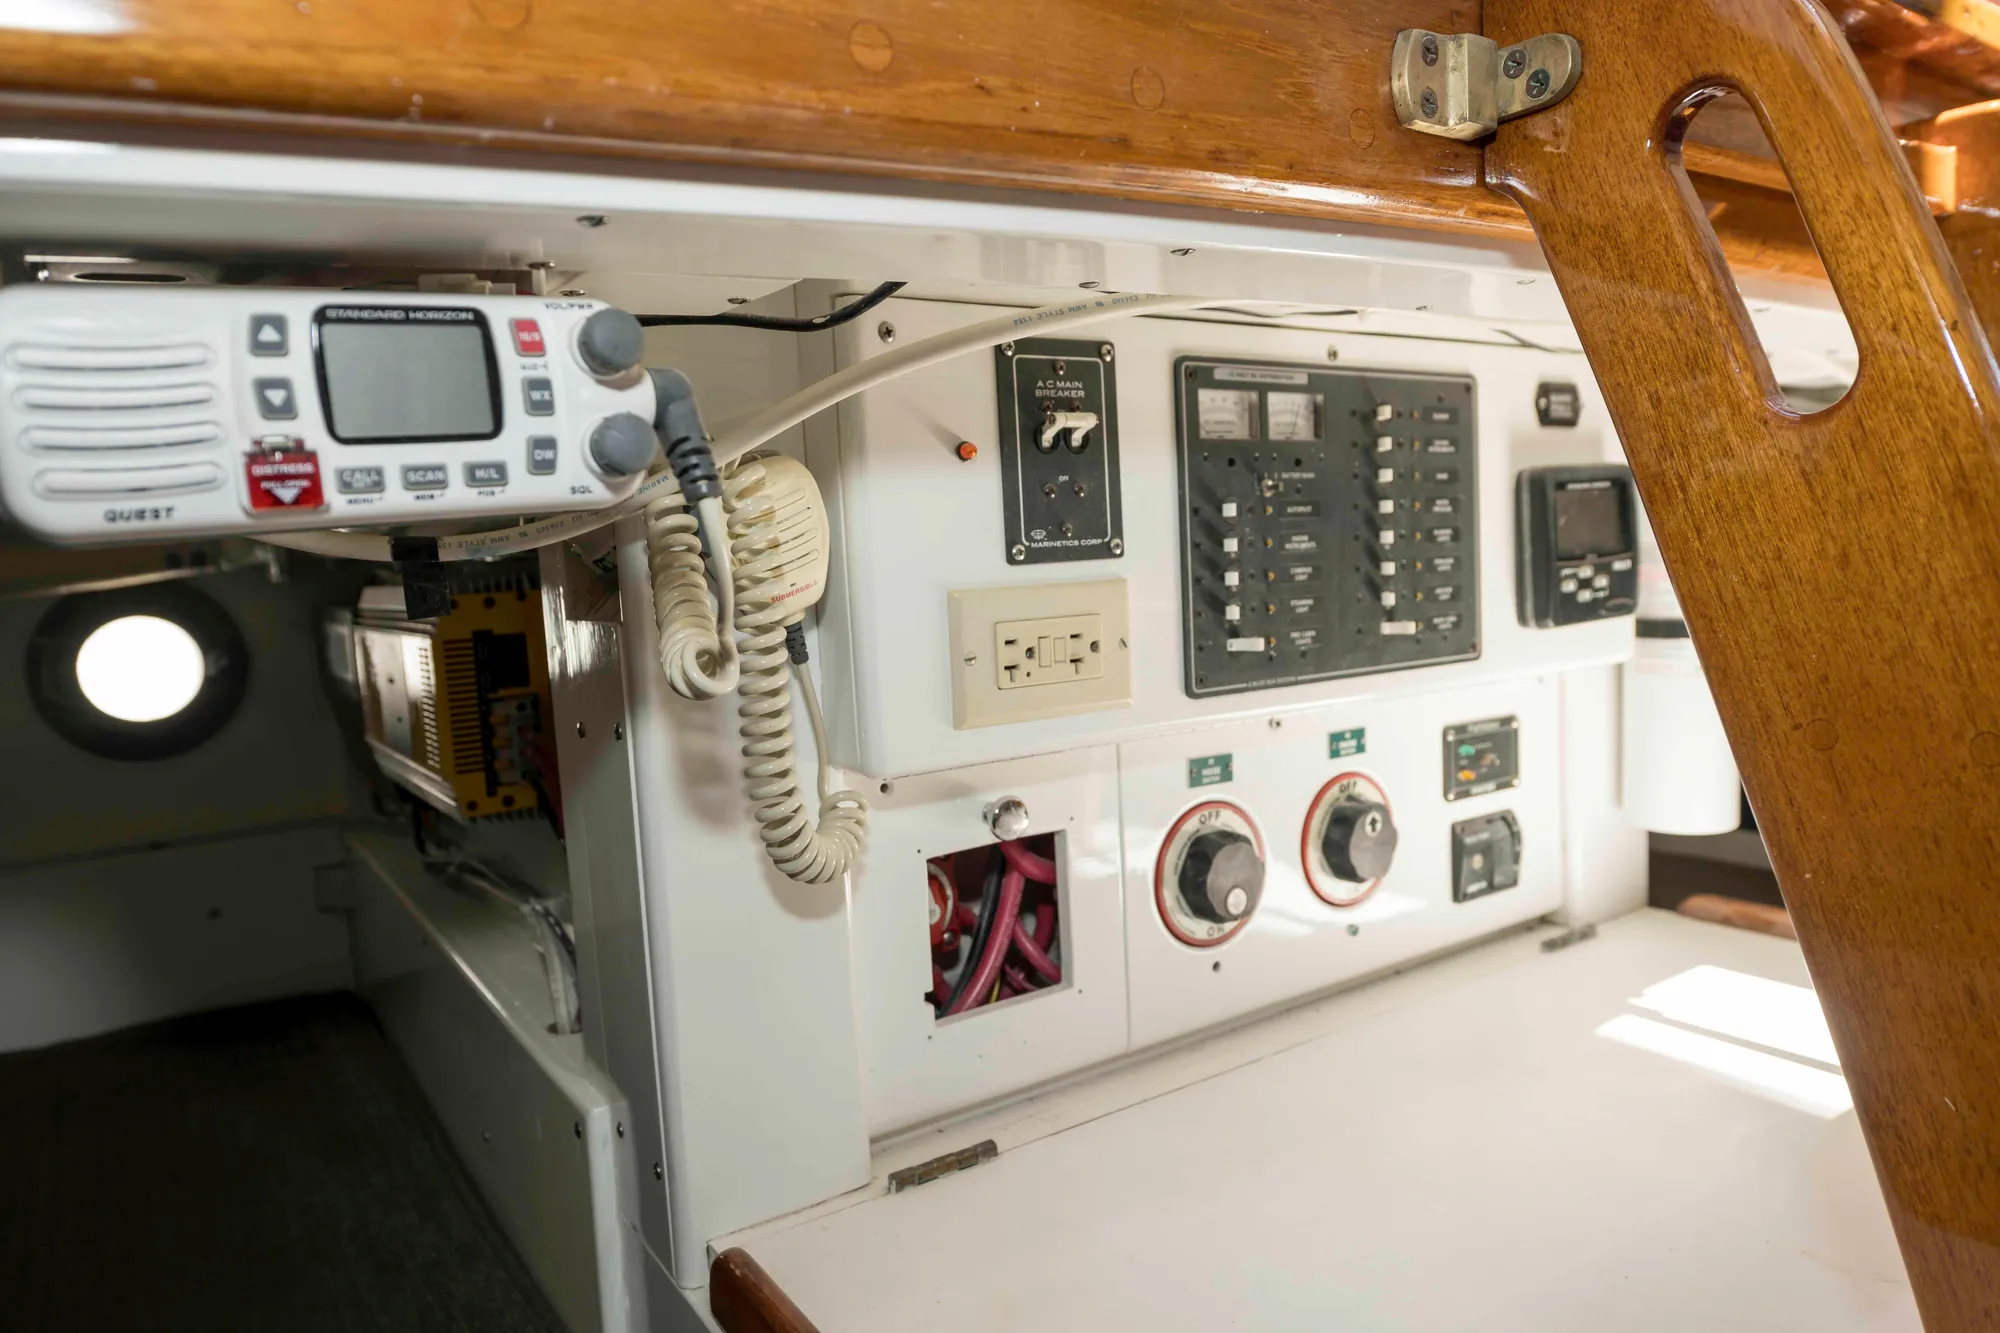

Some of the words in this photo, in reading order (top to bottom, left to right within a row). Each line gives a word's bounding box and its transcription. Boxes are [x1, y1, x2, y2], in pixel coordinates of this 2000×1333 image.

[1036, 308, 1065, 320] STYLE
[1068, 303, 1087, 313] AWM
[325, 308, 406, 320] STANDARD
[408, 310, 475, 321] HORIZON
[1013, 315, 1032, 325] 1354
[1056, 381, 1083, 389] MAIN
[1035, 389, 1085, 398] BREAKER
[533, 449, 555, 461] DW
[251, 462, 315, 477] DISTRESS
[342, 468, 380, 482] CALL
[474, 467, 500, 480] H/L
[406, 469, 445, 483] SCAN
[570, 485, 592, 495] SQL
[637, 474, 669, 495] MARINE
[103, 506, 174, 524] QUEST
[457, 538, 486, 548] STYLE
[490, 534, 510, 544] AWM
[1030, 539, 1079, 548] MARINETICS
[1080, 538, 1102, 546] CORP
[769, 580, 818, 603] SUBMERSIBLE
[1339, 781, 1358, 794] OFF
[1199, 810, 1221, 825] OFF
